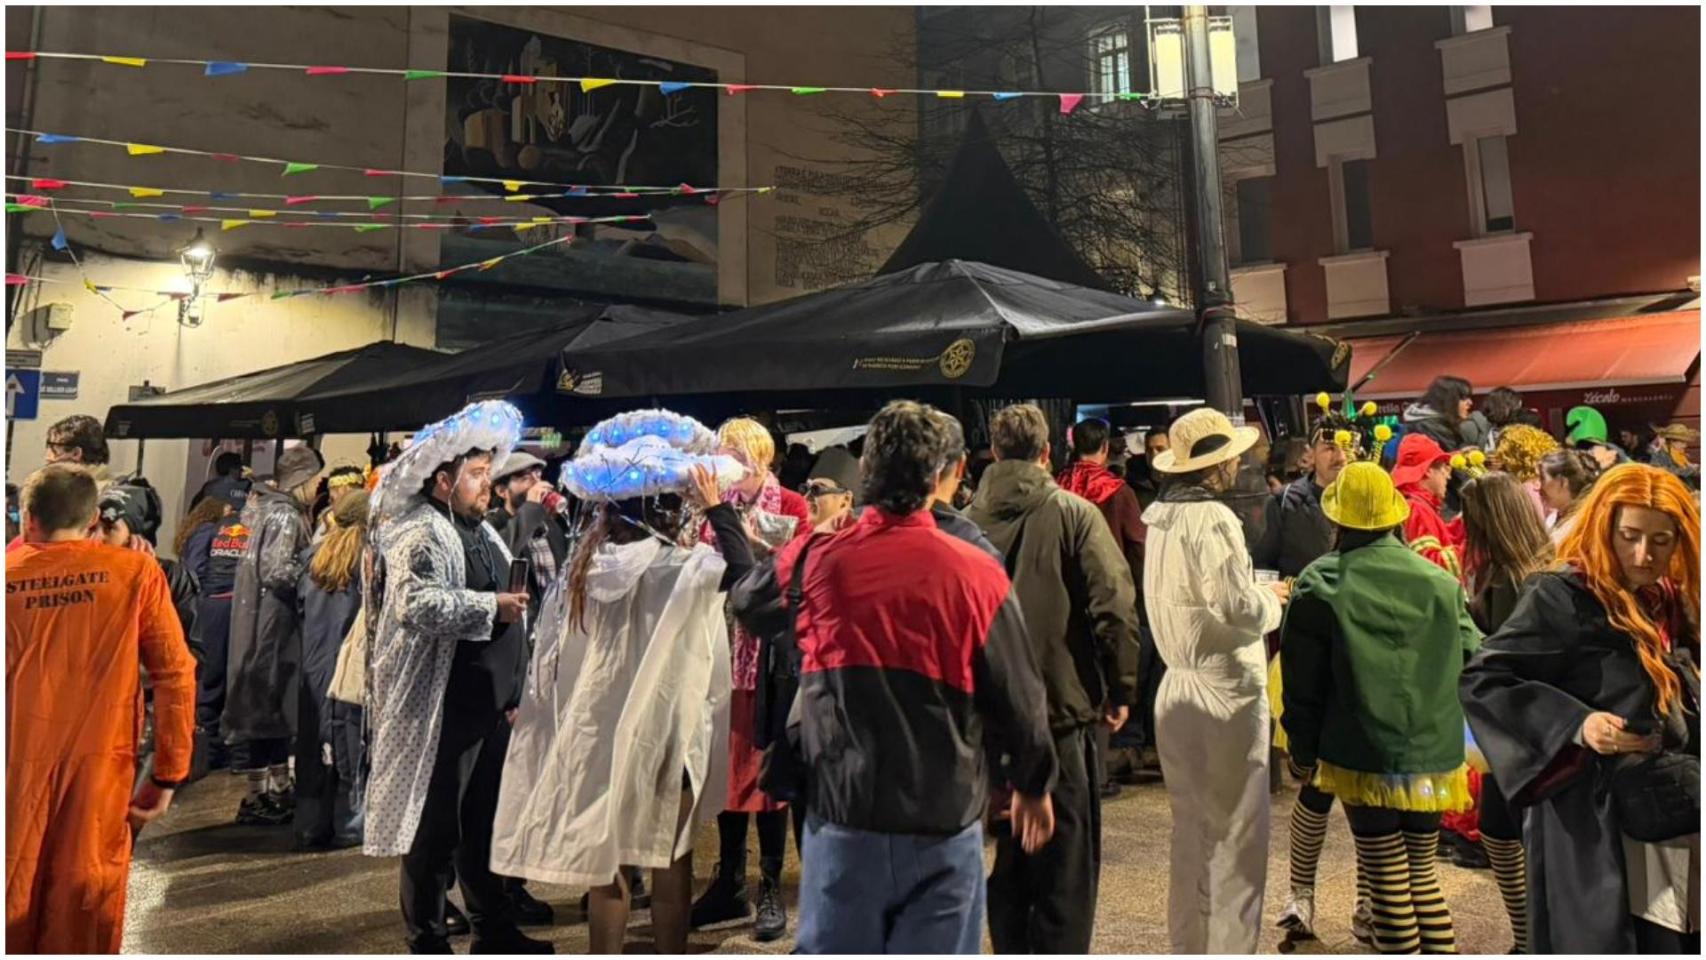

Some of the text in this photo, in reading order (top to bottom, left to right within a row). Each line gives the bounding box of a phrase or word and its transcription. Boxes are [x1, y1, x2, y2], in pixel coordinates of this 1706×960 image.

[212, 537, 230, 549] Red
[6, 571, 109, 593] STEELGATE
[25, 589, 95, 609] PRISON
